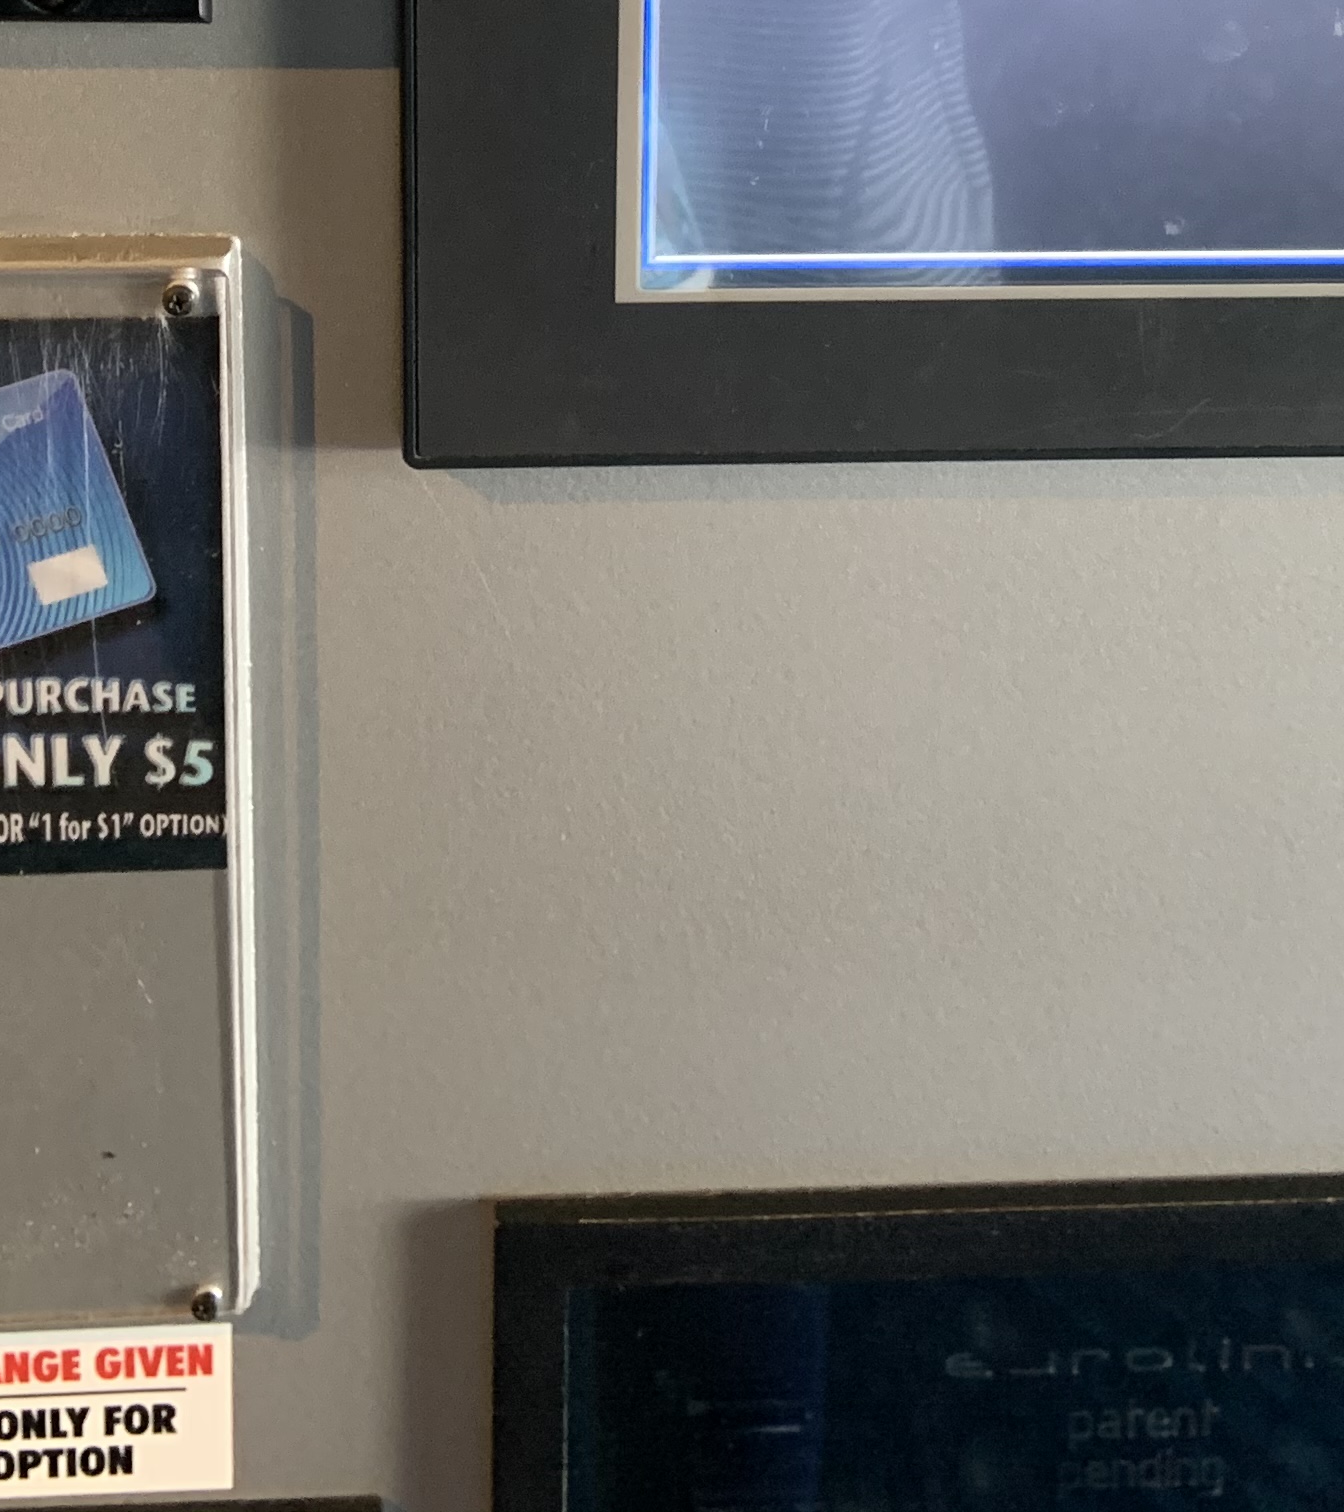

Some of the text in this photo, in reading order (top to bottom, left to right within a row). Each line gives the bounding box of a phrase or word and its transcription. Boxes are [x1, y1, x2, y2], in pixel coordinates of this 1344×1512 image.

[2, 407, 43, 431] Card
[13, 506, 82, 542] 0000
[144, 733, 215, 790] $5
[59, 811, 92, 842] for
[94, 1343, 214, 1381] GIVEN
[104, 1402, 177, 1437] FOR
